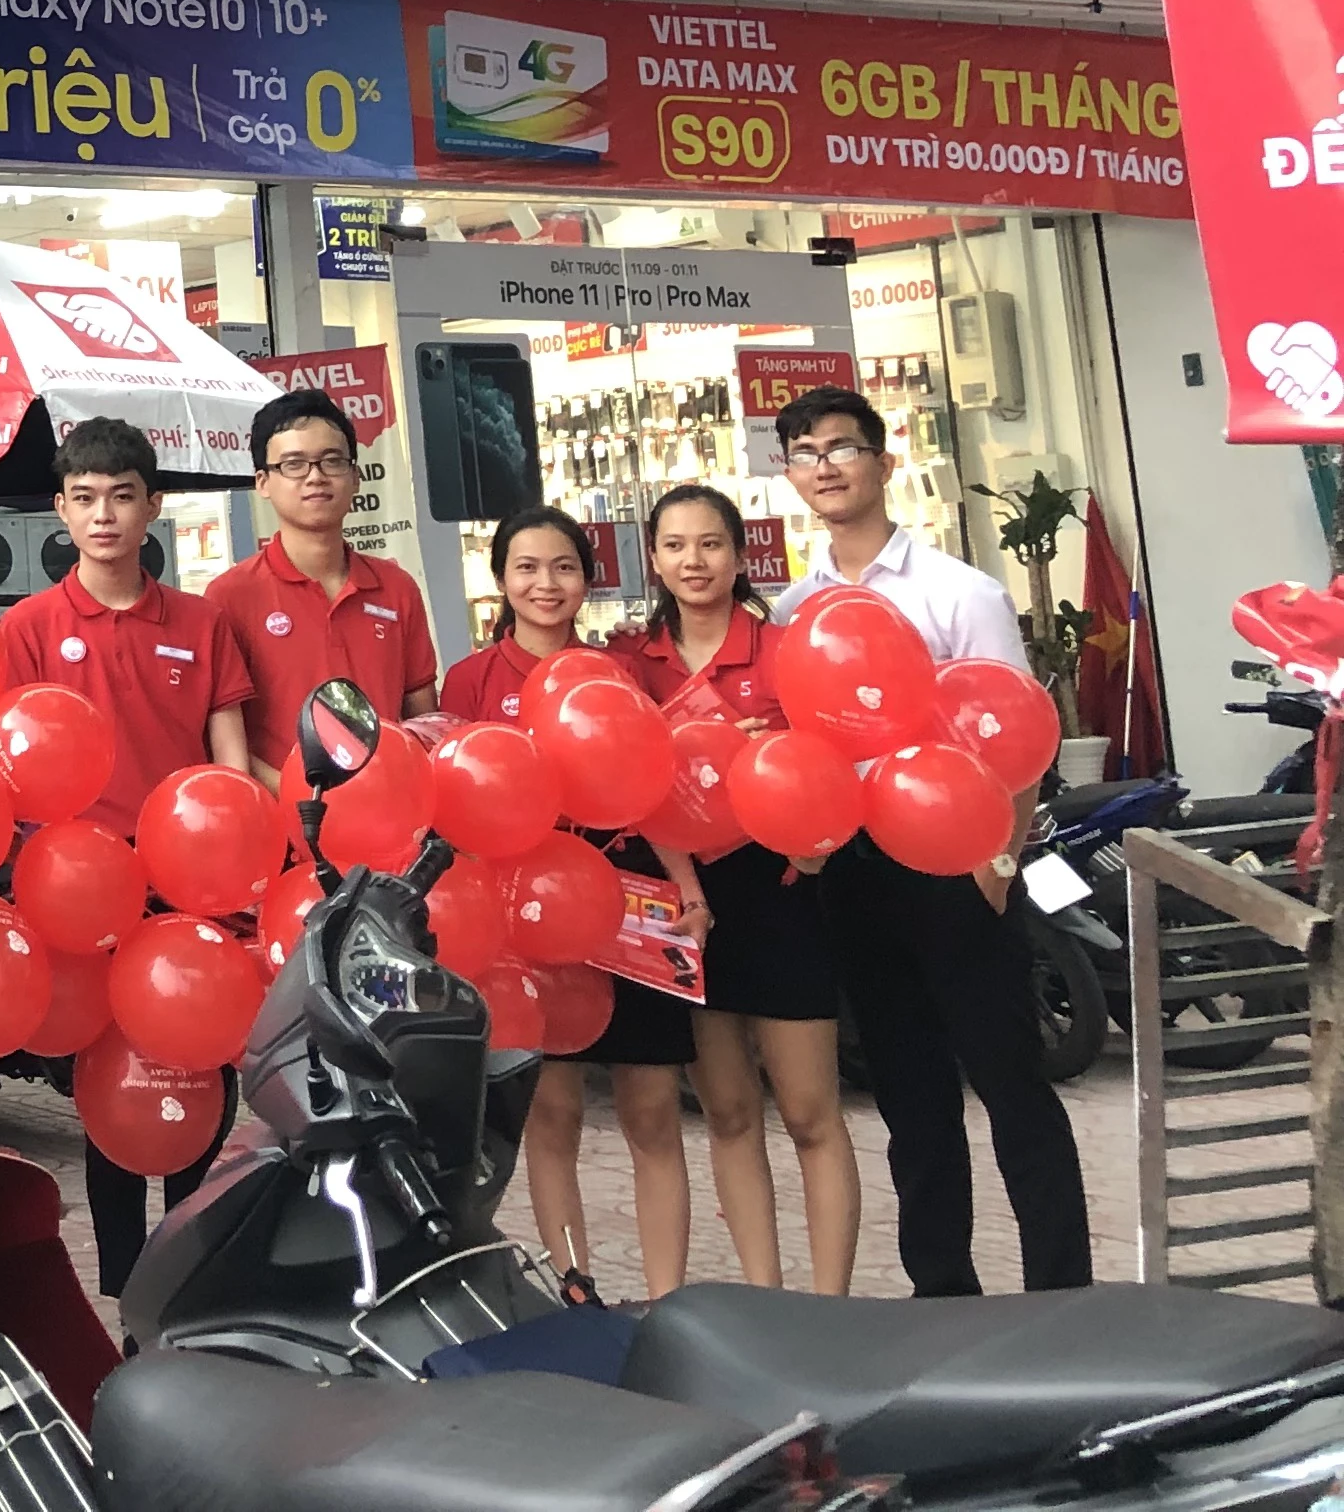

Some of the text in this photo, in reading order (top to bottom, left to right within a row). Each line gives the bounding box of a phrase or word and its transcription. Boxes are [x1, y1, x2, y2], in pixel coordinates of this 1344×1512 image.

[648, 14, 777, 52] VIETTEL
[516, 37, 576, 86] 4G
[638, 55, 799, 95] DATA MAX
[231, 66, 288, 102] Trả
[821, 58, 942, 120] 6GB
[980, 62, 1182, 139] THÁNG
[227, 110, 297, 156] Góp
[671, 113, 773, 170] S90
[825, 134, 888, 169] DUY
[892, 133, 941, 172] TRÌ
[944, 141, 1071, 178] 90.000Đ
[1092, 141, 1185, 187] THÁNG
[328, 228, 341, 246] 2
[500, 280, 575, 306] iPhone
[580, 284, 599, 307] 11
[666, 287, 701, 308] Pro
[706, 287, 751, 309] Max
[851, 278, 935, 310] 30.000Đ
[262, 362, 365, 393] RAVEL
[755, 355, 789, 376] TẶNG
[357, 538, 387, 551] DAYS
[382, 519, 413, 534] DATA
